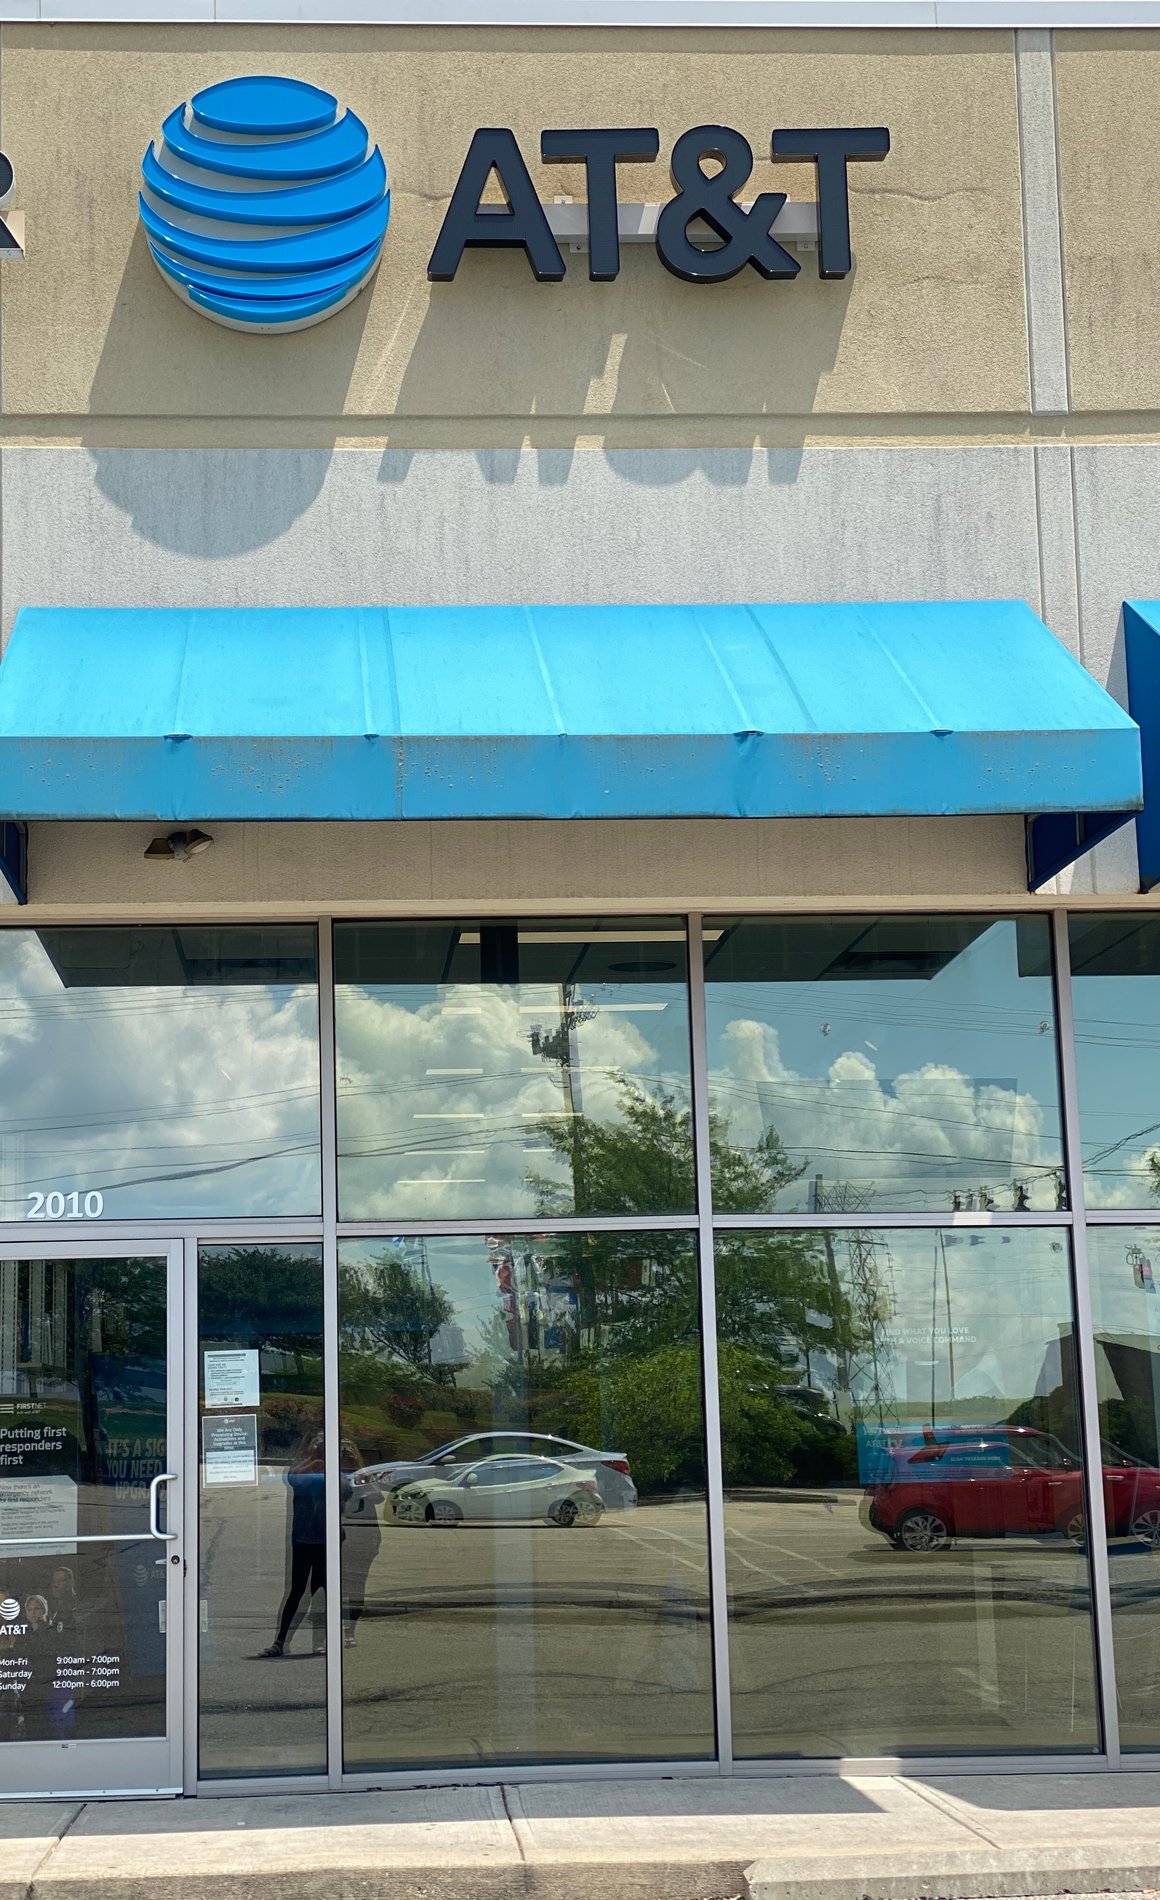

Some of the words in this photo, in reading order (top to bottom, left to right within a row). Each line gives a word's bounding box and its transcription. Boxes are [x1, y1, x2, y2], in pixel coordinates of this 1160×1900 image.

[427, 125, 890, 284] AT&T
[27, 1190, 104, 1219] 2010
[902, 1327, 927, 1336] WHAT
[928, 1327, 946, 1335] YOU
[906, 1336, 932, 1344] VOICE
[0, 1427, 41, 1440] Putting
[43, 1426, 67, 1437] first
[0, 1440, 63, 1454] responders
[132, 1438, 142, 1458] A
[144, 1438, 167, 1458] SIG
[0, 1454, 24, 1466] first
[106, 1459, 128, 1479] YOU
[130, 1459, 163, 1478] NEED
[0, 1624, 28, 1635] AT&T
[0, 1657, 28, 1666] Mon-Fri
[56, 1656, 85, 1665] 9:00am
[91, 1655, 120, 1665] 7:00pm
[0, 1669, 33, 1680] Saturday
[56, 1668, 85, 1677] 9:00am
[91, 1667, 120, 1677] 7:00pm
[0, 1682, 26, 1692] Sunday
[52, 1680, 84, 1690] 12:00pm
[90, 1679, 120, 1689] 6:00pm
